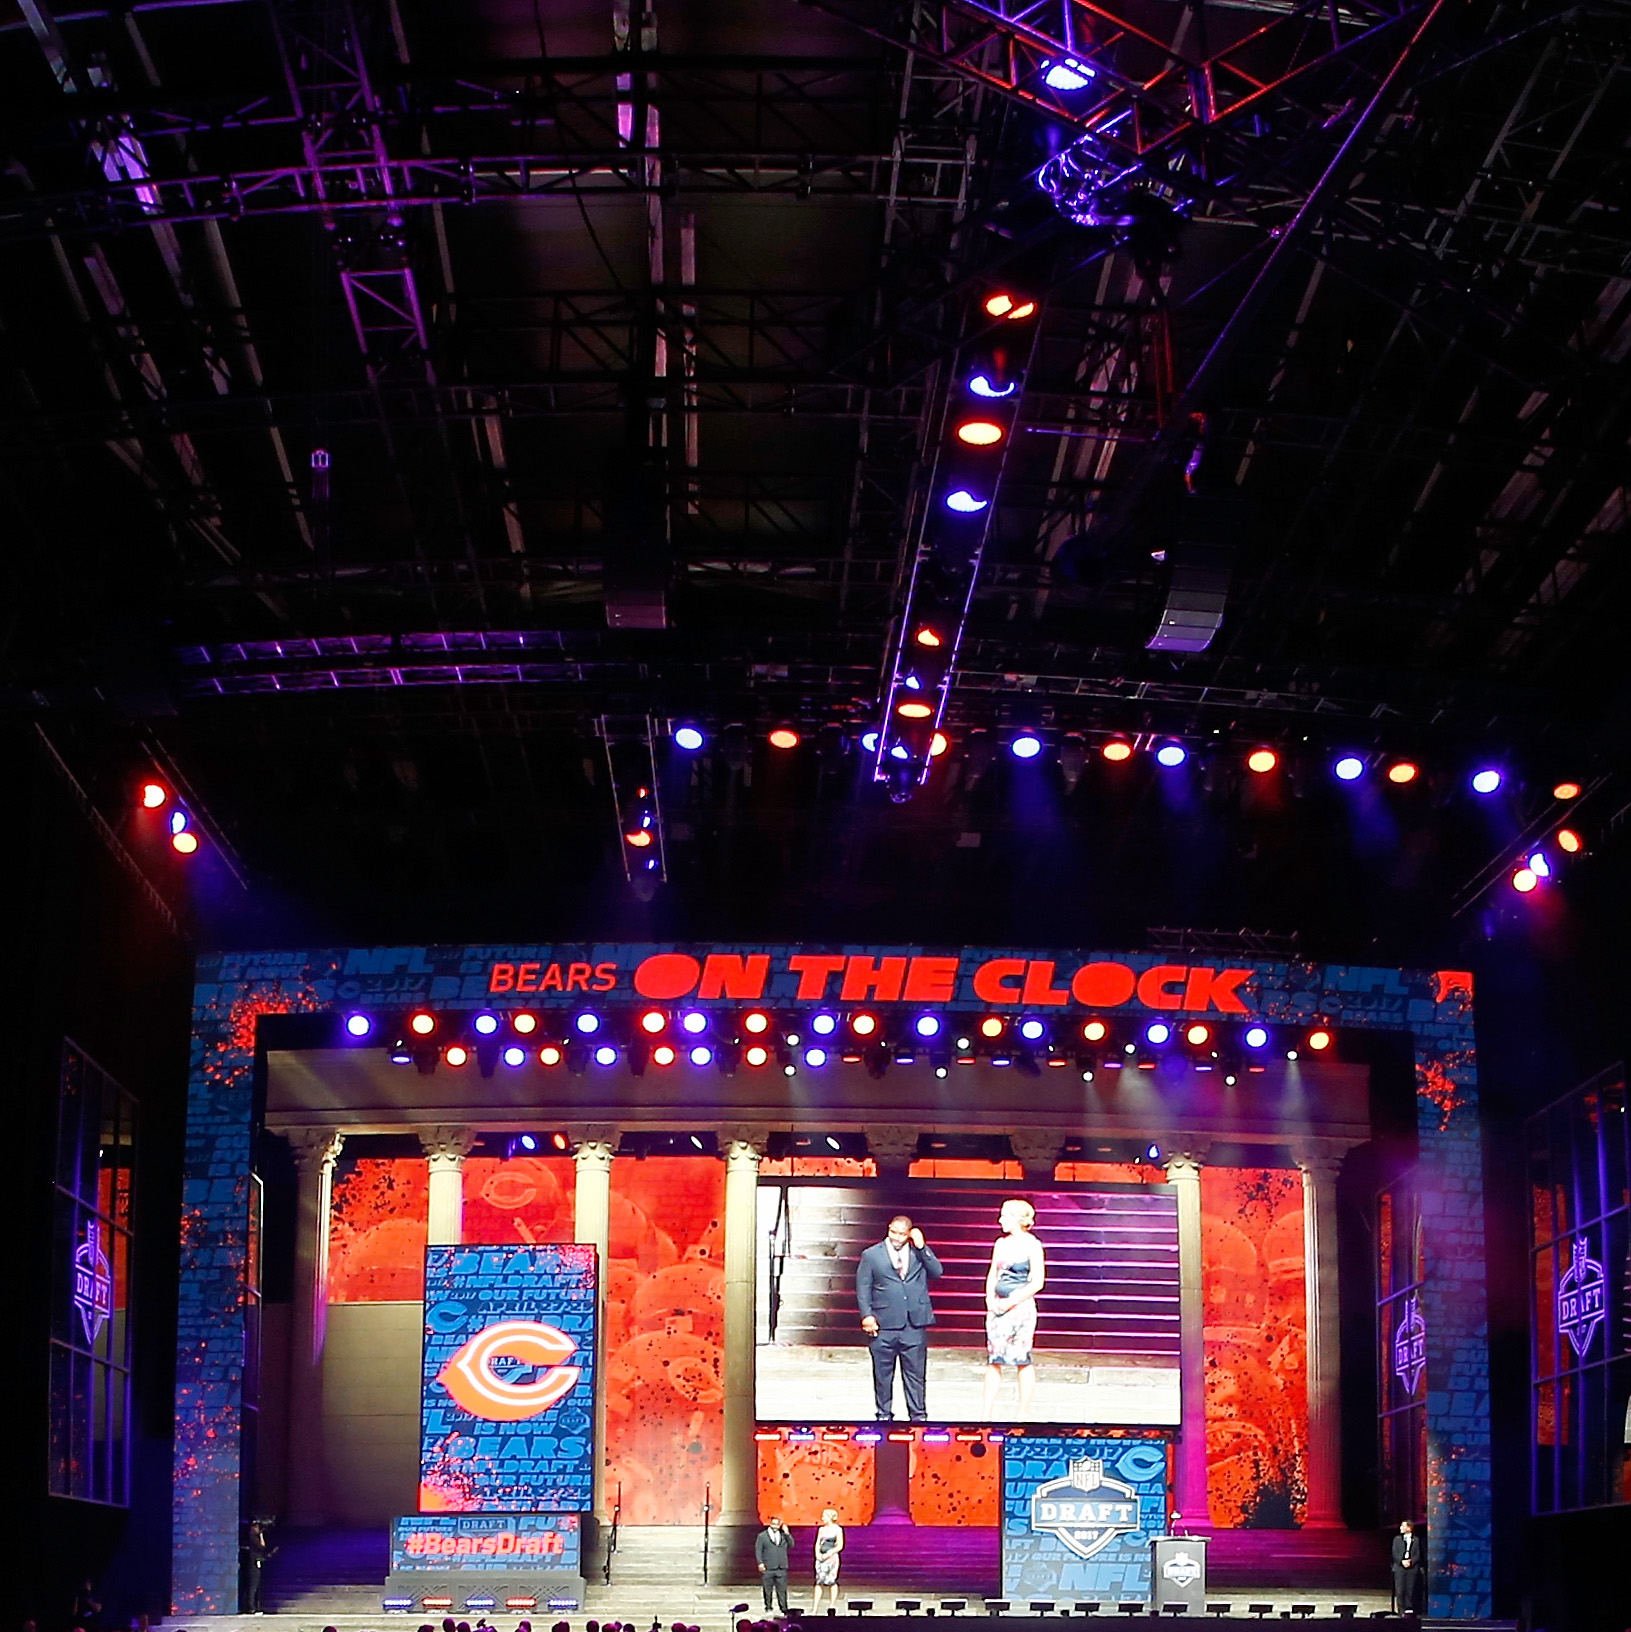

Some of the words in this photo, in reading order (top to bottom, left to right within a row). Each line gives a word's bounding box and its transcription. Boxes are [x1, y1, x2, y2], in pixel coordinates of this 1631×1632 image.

[489, 962, 618, 993] BEARS
[634, 953, 770, 1000] ON
[787, 954, 960, 1002] THE
[972, 957, 1256, 1014] CLOCK
[1397, 1340, 1425, 1366] DRFT
[474, 1422, 498, 1435] IS
[498, 1422, 557, 1435] NOW
[448, 1436, 587, 1459] BEARS
[1075, 1473, 1099, 1487] NFL
[1039, 1503, 1134, 1522] DRAFT
[462, 1519, 506, 1530] DRAFT
[405, 1531, 565, 1556] #BearsDraft
[1058, 1563, 1150, 1592] NFL
